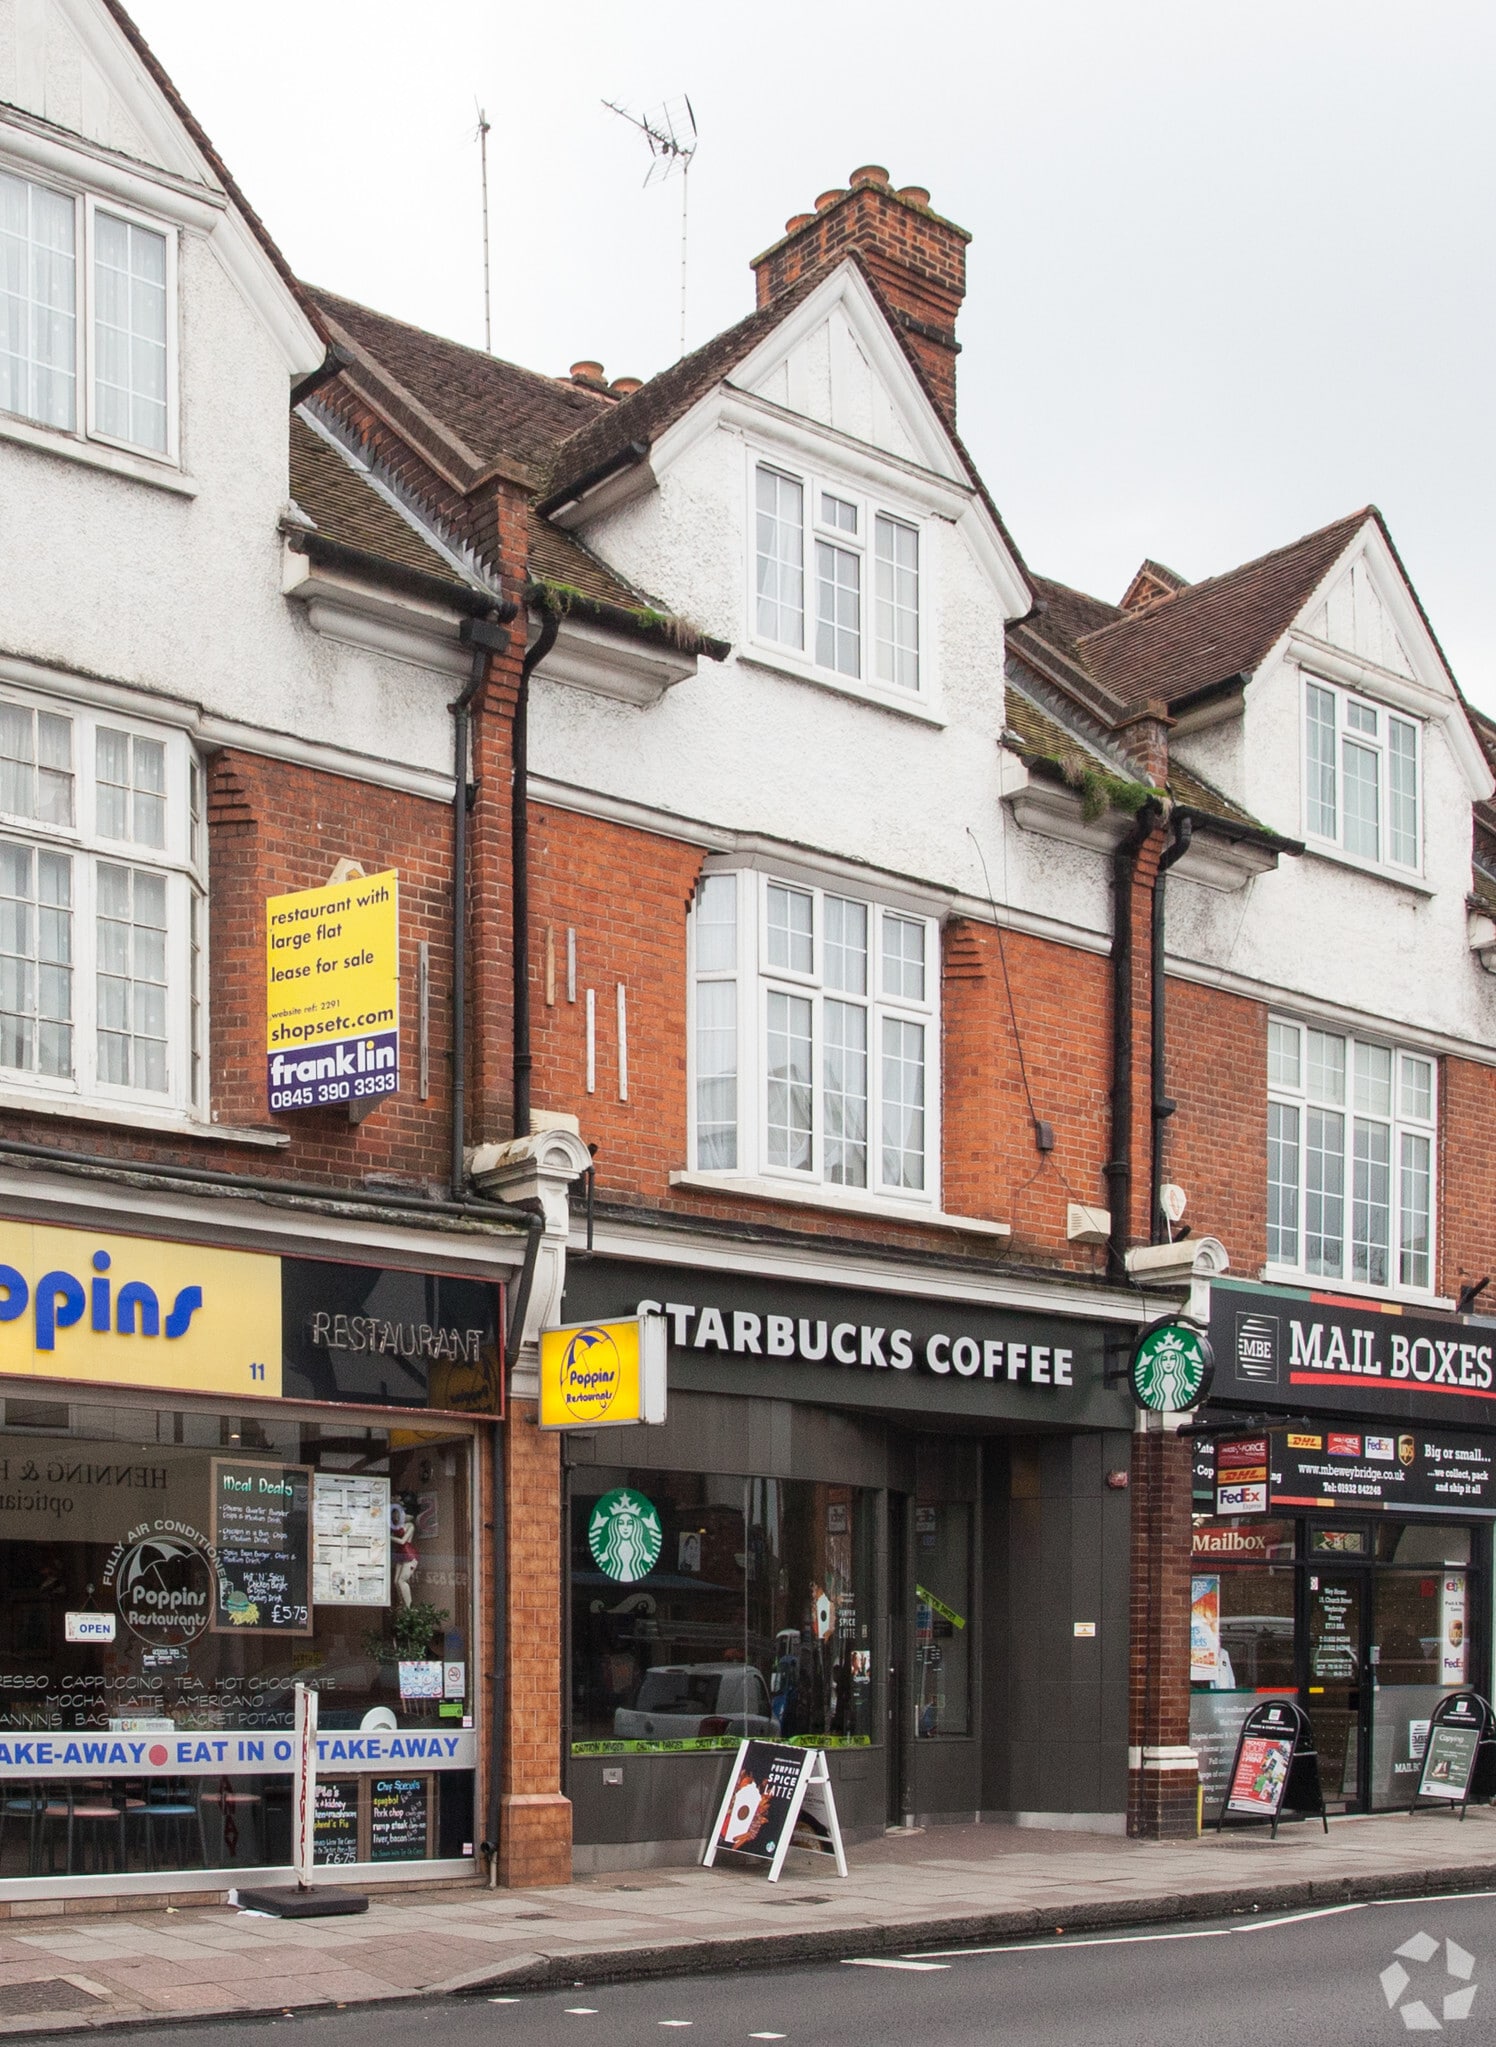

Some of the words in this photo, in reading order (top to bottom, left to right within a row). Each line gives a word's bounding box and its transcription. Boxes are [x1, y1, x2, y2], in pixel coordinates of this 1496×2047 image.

[271, 897, 351, 925] restaurant
[357, 886, 389, 908] with
[271, 932, 311, 950] large
[317, 923, 342, 940] flat
[271, 964, 311, 982] lease
[316, 957, 338, 974] for
[344, 949, 374, 969] sale
[271, 1007, 301, 1018] website
[321, 1000, 340, 1011] 2291
[271, 1008, 394, 1041] shopsetc.com
[271, 1040, 395, 1086] franklin
[271, 1087, 313, 1108] 0845
[318, 1082, 349, 1101] 390
[354, 1073, 395, 1096] 3333
[313, 1311, 484, 1362] RESTAURANT
[1243, 1338, 1271, 1358] MBE
[1289, 1320, 1382, 1375] MAIL
[1391, 1334, 1493, 1388] BOXES
[926, 1333, 1073, 1386] COFFEE
[249, 1363, 265, 1381] 11
[570, 1368, 615, 1388] Poppins
[1292, 1437, 1317, 1446] DHL
[1367, 1438, 1390, 1451] FedEx
[1425, 1444, 1441, 1461] Big
[1443, 1449, 1454, 1459] or
[1225, 1470, 1259, 1480] DHL
[1298, 1463, 1405, 1481] www.mbeweybridge.co.uk
[1445, 1469, 1470, 1481] collect,
[1472, 1470, 1489, 1482] pack
[223, 1475, 251, 1492] Meal
[259, 1477, 293, 1497] Deals
[1435, 1482, 1448, 1492] and
[1449, 1483, 1464, 1495] ship
[1465, 1484, 1471, 1493] it
[1472, 1484, 1481, 1494] all
[1220, 1488, 1260, 1504] FedEx
[1192, 1531, 1266, 1551] Mailbox
[102, 1540, 125, 1586] FULLY
[127, 1523, 150, 1543] AIR
[133, 1585, 206, 1609] Poppins
[129, 1611, 207, 1626] Restaurants
[839, 1618, 856, 1626] SPICE
[80, 1624, 110, 1633] OPEN
[1444, 1658, 1464, 1668] FedE
[61, 1675, 163, 1690] CAPPUCCINO
[174, 1676, 204, 1689] TEA
[215, 1677, 245, 1689] HOT
[46, 1695, 106, 1708] MOCHA
[118, 1695, 163, 1708] LATTE
[175, 1695, 264, 1708] AMERICANO
[178, 1712, 234, 1725] JACKET
[238, 1712, 296, 1725] POTATO
[177, 1741, 228, 1762] EAT
[238, 1741, 264, 1761] IN
[274, 1740, 296, 1761] O
[317, 1737, 459, 1761] TAKE-AWAY
[771, 1763, 800, 1775] PUMPKIN
[768, 1773, 797, 1786] SPICE
[764, 1784, 793, 1800] LATTE
[373, 1807, 388, 1818] Pork
[389, 1807, 404, 1819] chop
